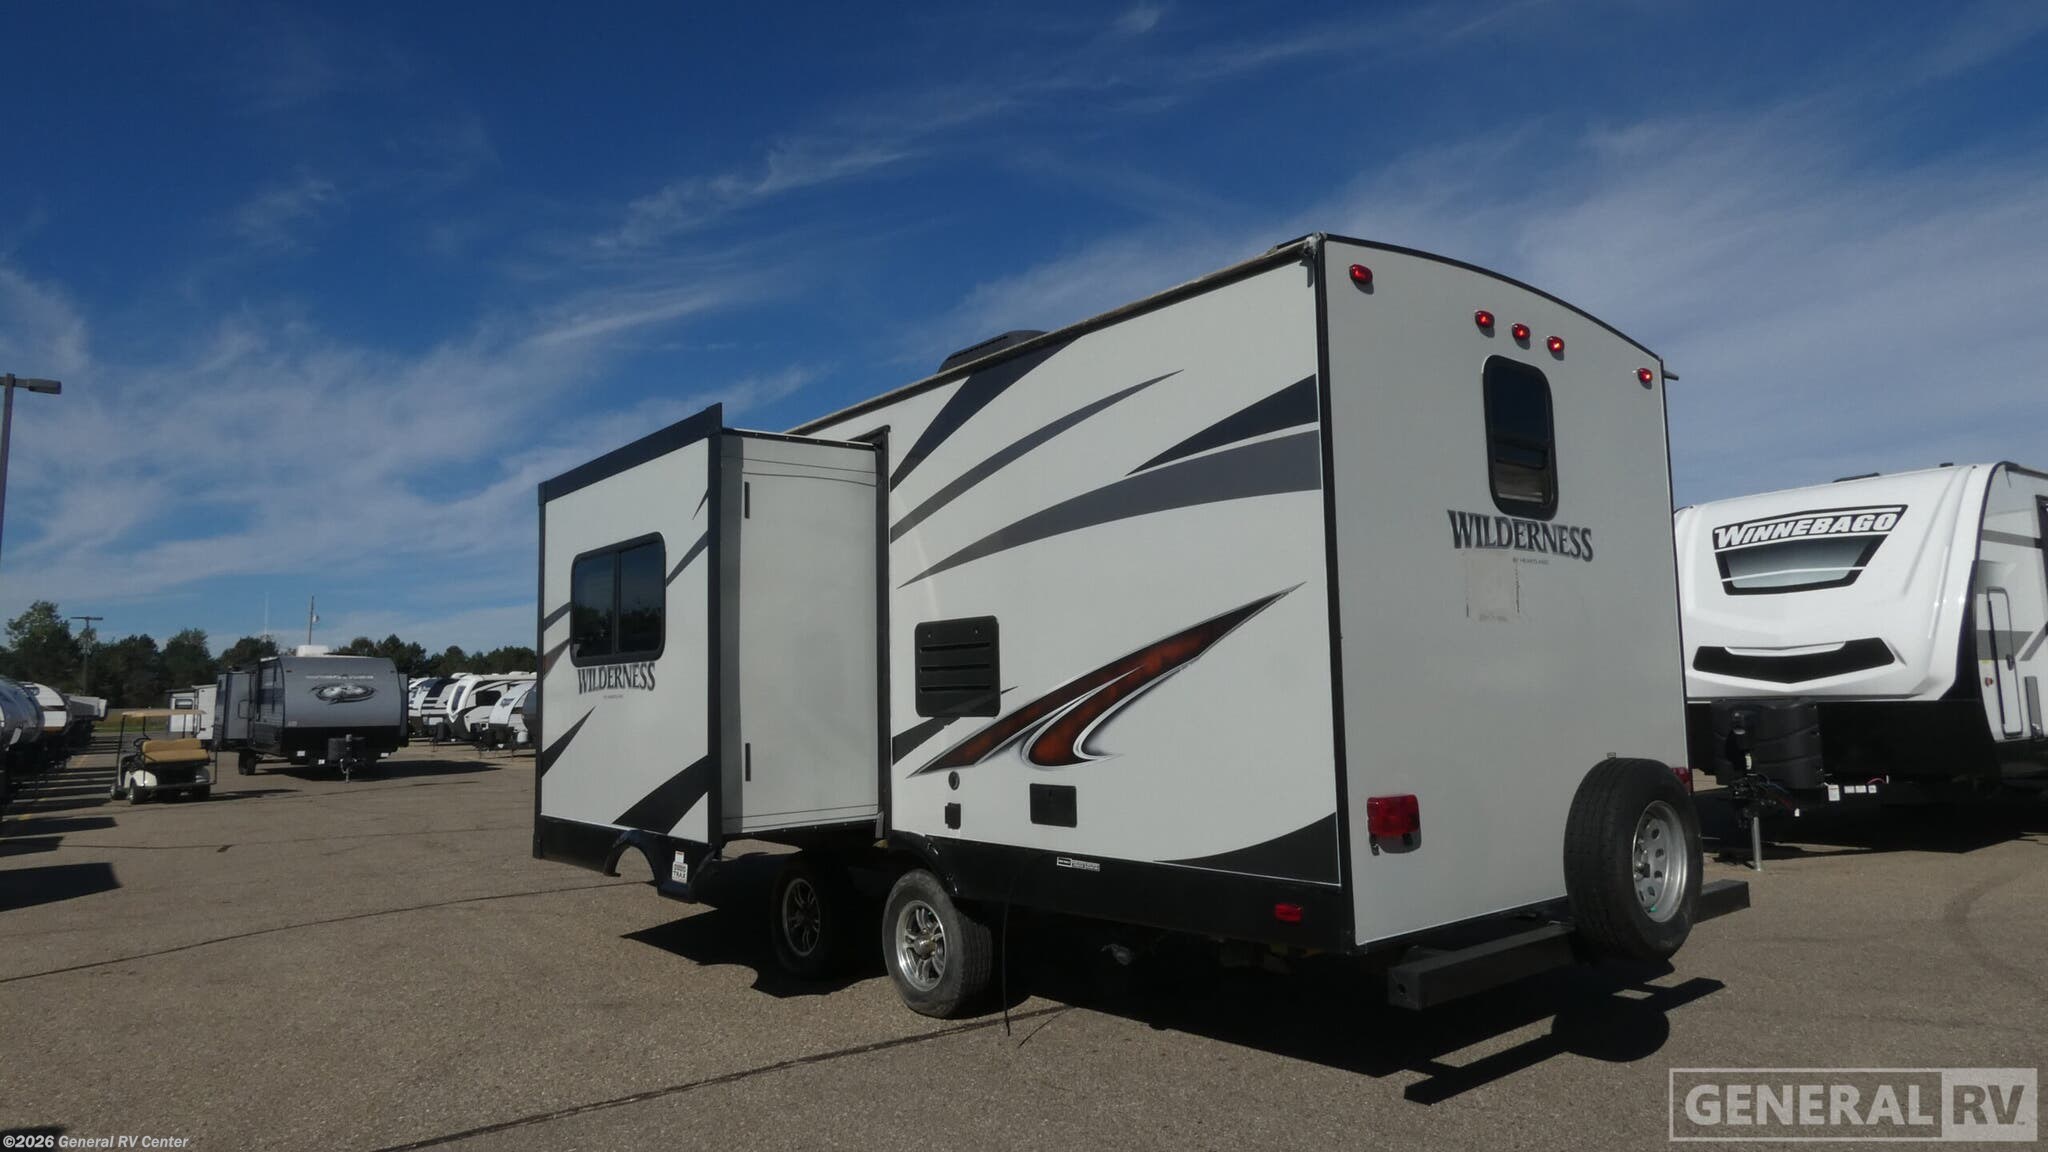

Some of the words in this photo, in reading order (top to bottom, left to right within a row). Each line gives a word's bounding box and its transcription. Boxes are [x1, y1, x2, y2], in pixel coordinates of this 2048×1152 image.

[1447, 509, 1594, 562] WILDERNESS
[1714, 512, 1898, 548] WINNEBAGO
[577, 661, 656, 695] WILDERNESS
